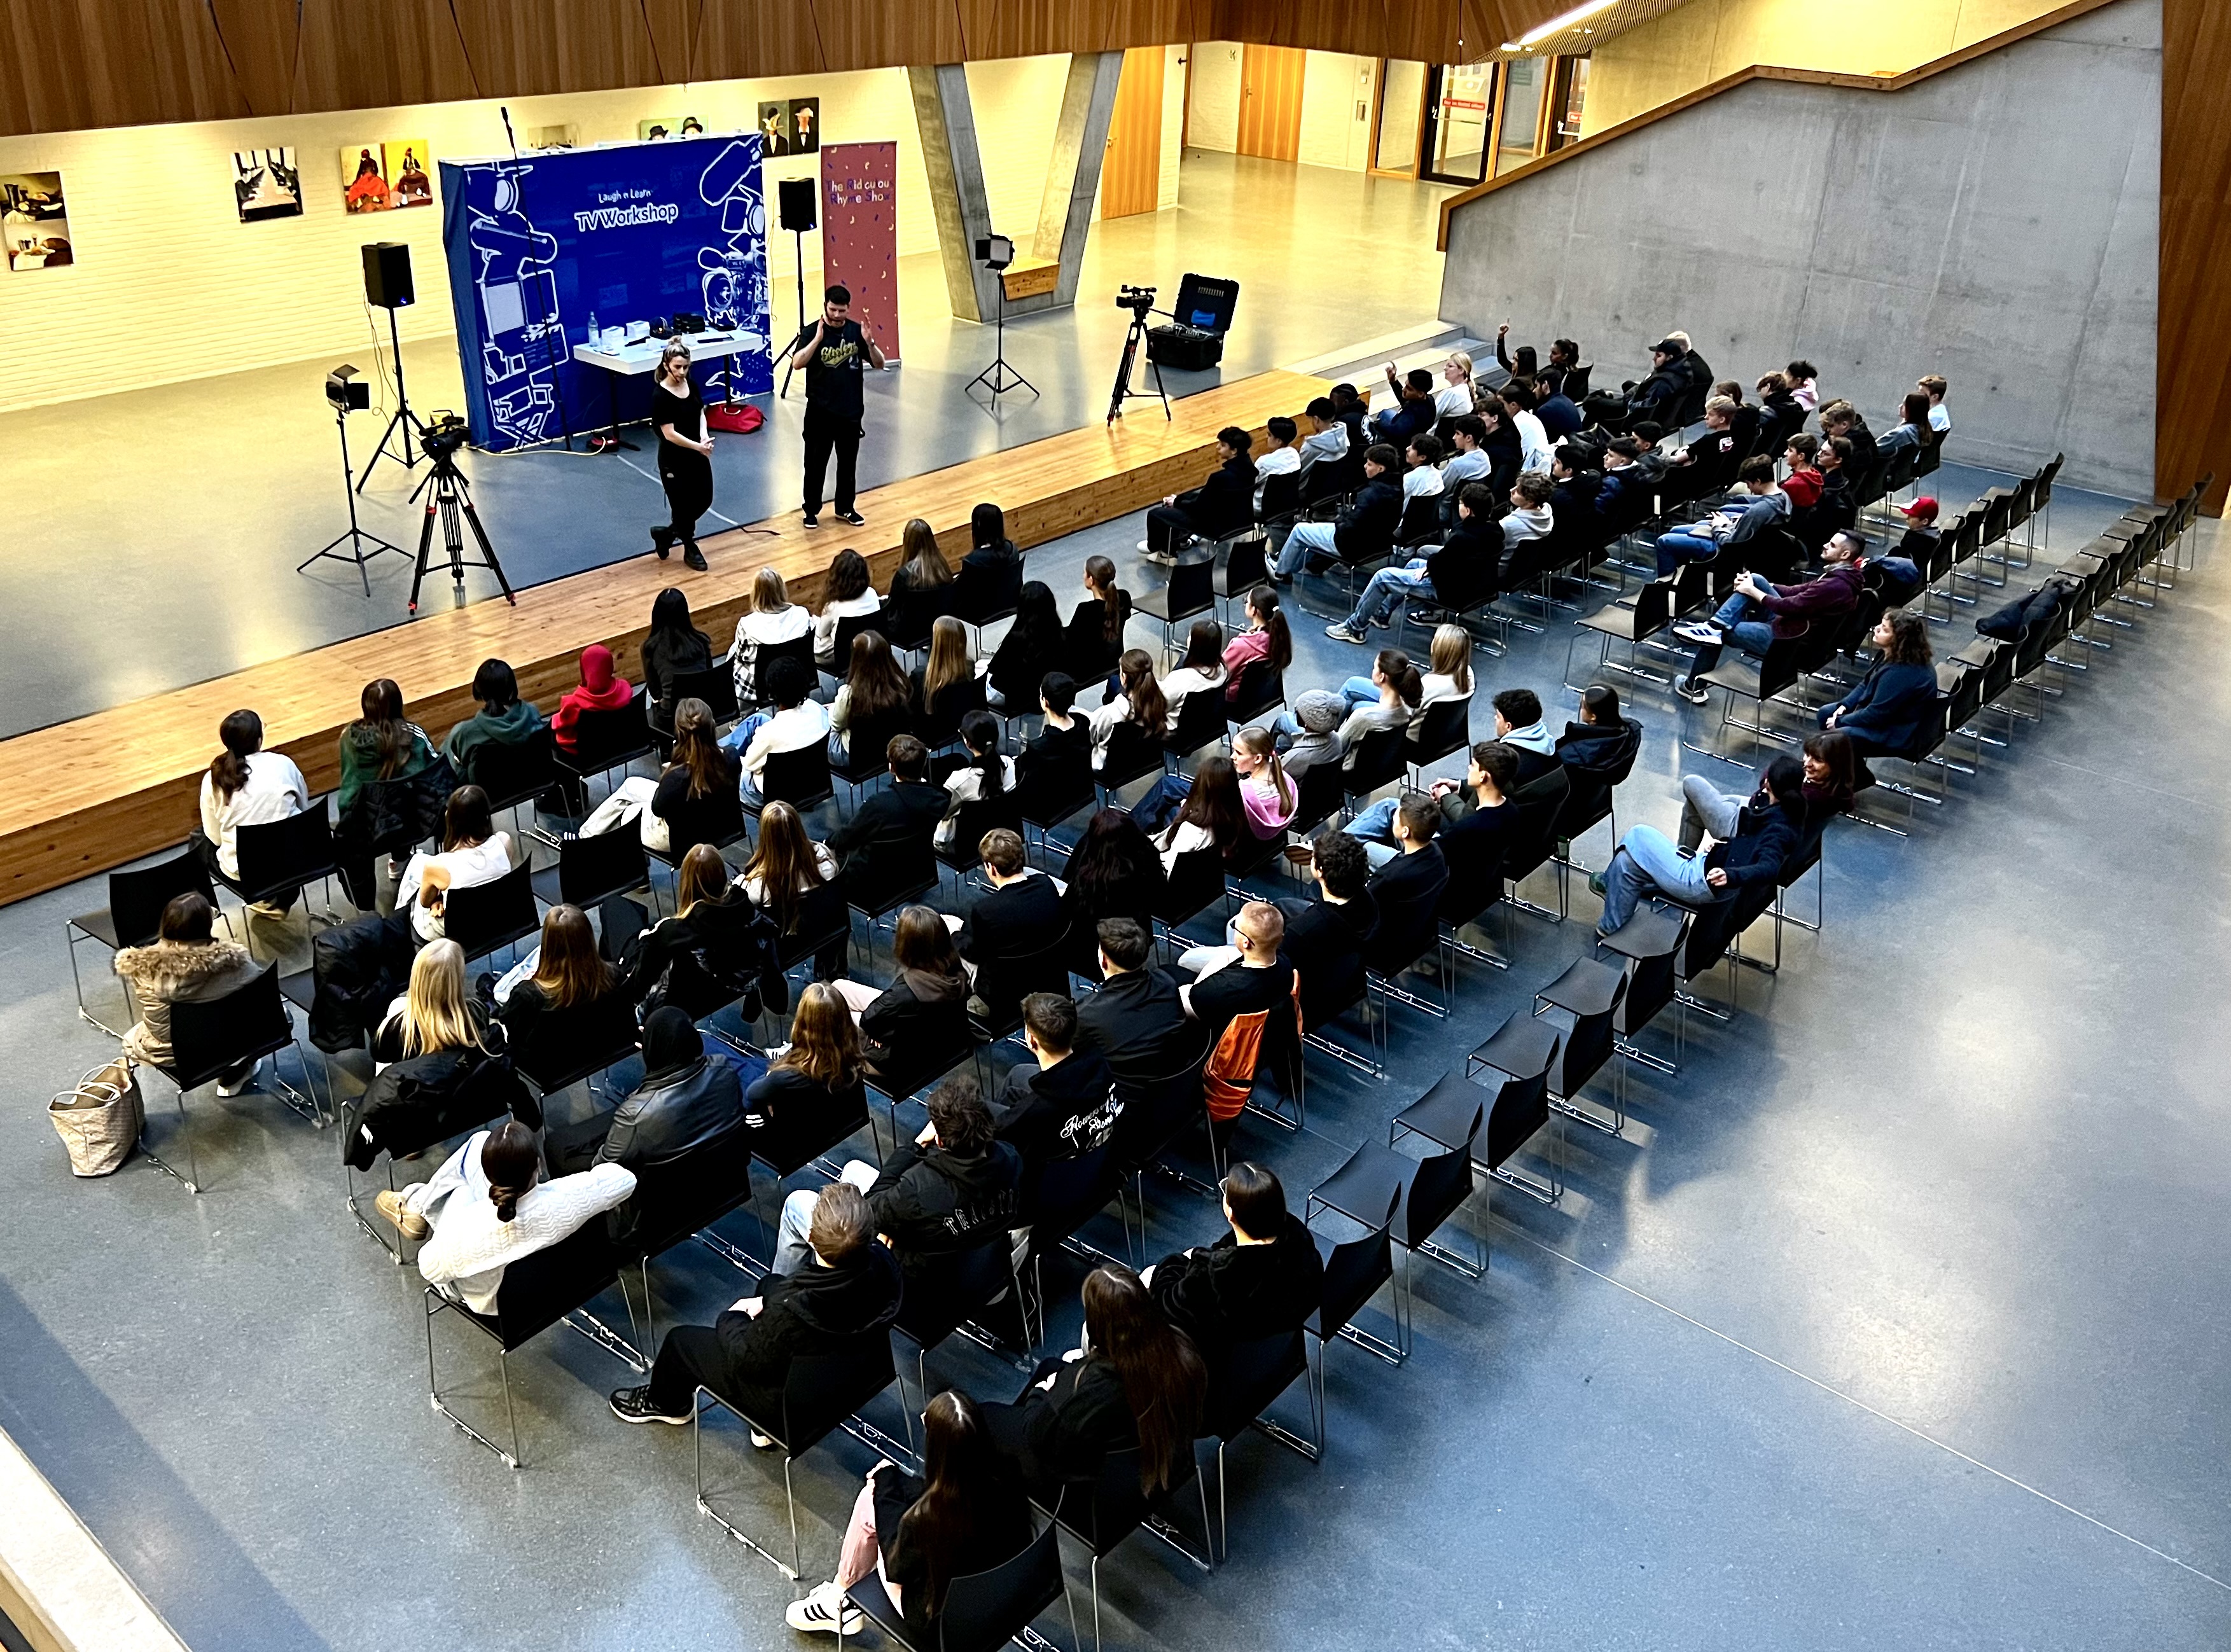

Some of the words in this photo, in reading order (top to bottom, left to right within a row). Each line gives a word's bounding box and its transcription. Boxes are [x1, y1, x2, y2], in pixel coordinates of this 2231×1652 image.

[827, 180, 843, 191] The
[847, 178, 893, 190] Ridculou
[598, 190, 622, 203] Laugh
[630, 188, 651, 198] Learn
[830, 193, 862, 207] Rhyme
[865, 190, 891, 202] Show
[574, 211, 598, 232] TV
[599, 202, 679, 228] Workshop
